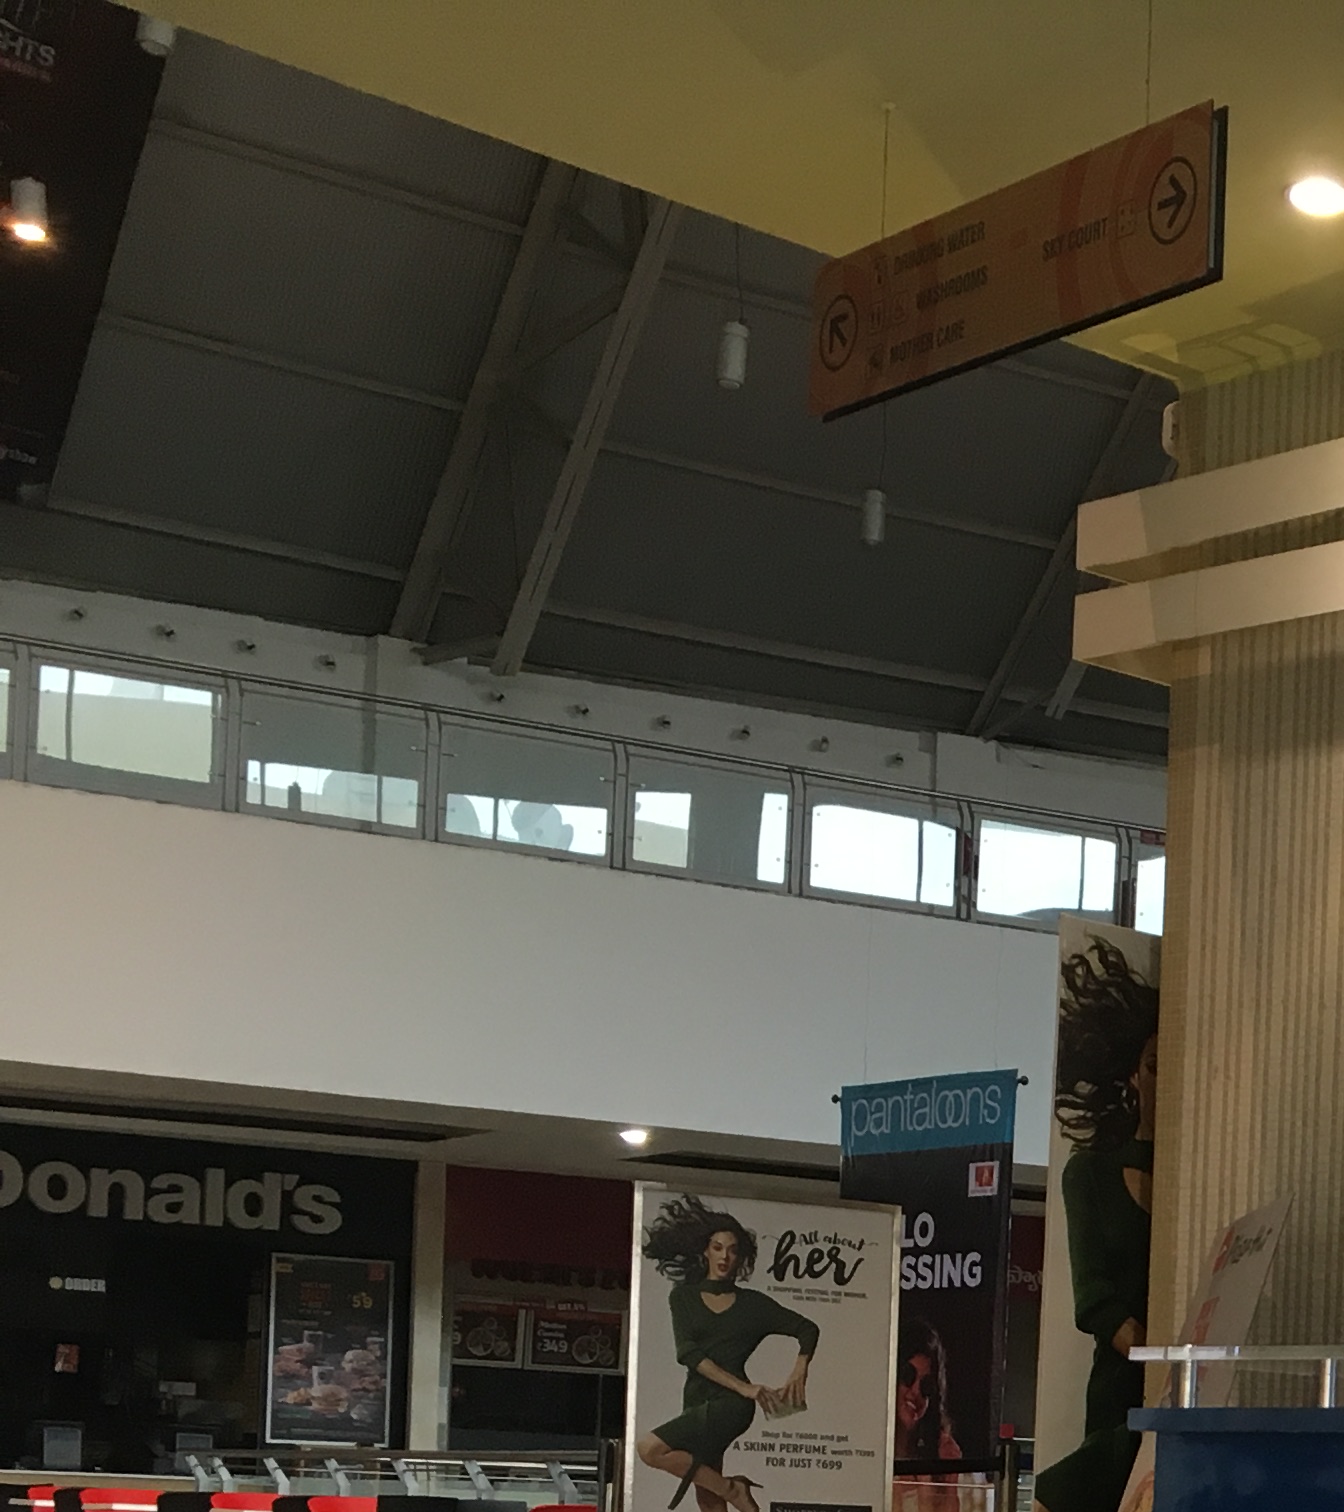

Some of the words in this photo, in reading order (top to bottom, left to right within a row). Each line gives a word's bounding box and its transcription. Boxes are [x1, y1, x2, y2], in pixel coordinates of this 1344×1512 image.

[894, 238, 944, 275] DRINKING
[947, 221, 986, 254] WATER
[1042, 235, 1065, 262] SKY
[1068, 218, 1108, 252] COURT
[916, 265, 988, 311] WASHROOMS
[890, 332, 933, 364] MOTHER
[936, 319, 965, 347] CARE
[849, 1082, 1002, 1141] pantaloons
[767, 1230, 865, 1286] her
[796, 1230, 819, 1246] All
[823, 1232, 872, 1252] about
[64, 1277, 106, 1293] ORDER
[732, 1440, 741, 1451] A
[743, 1441, 776, 1452] SKINN
[779, 1443, 828, 1455] PERFUME
[765, 1457, 786, 1468] FOR
[788, 1458, 812, 1469] JUST
[815, 1459, 843, 1470] ₹699
